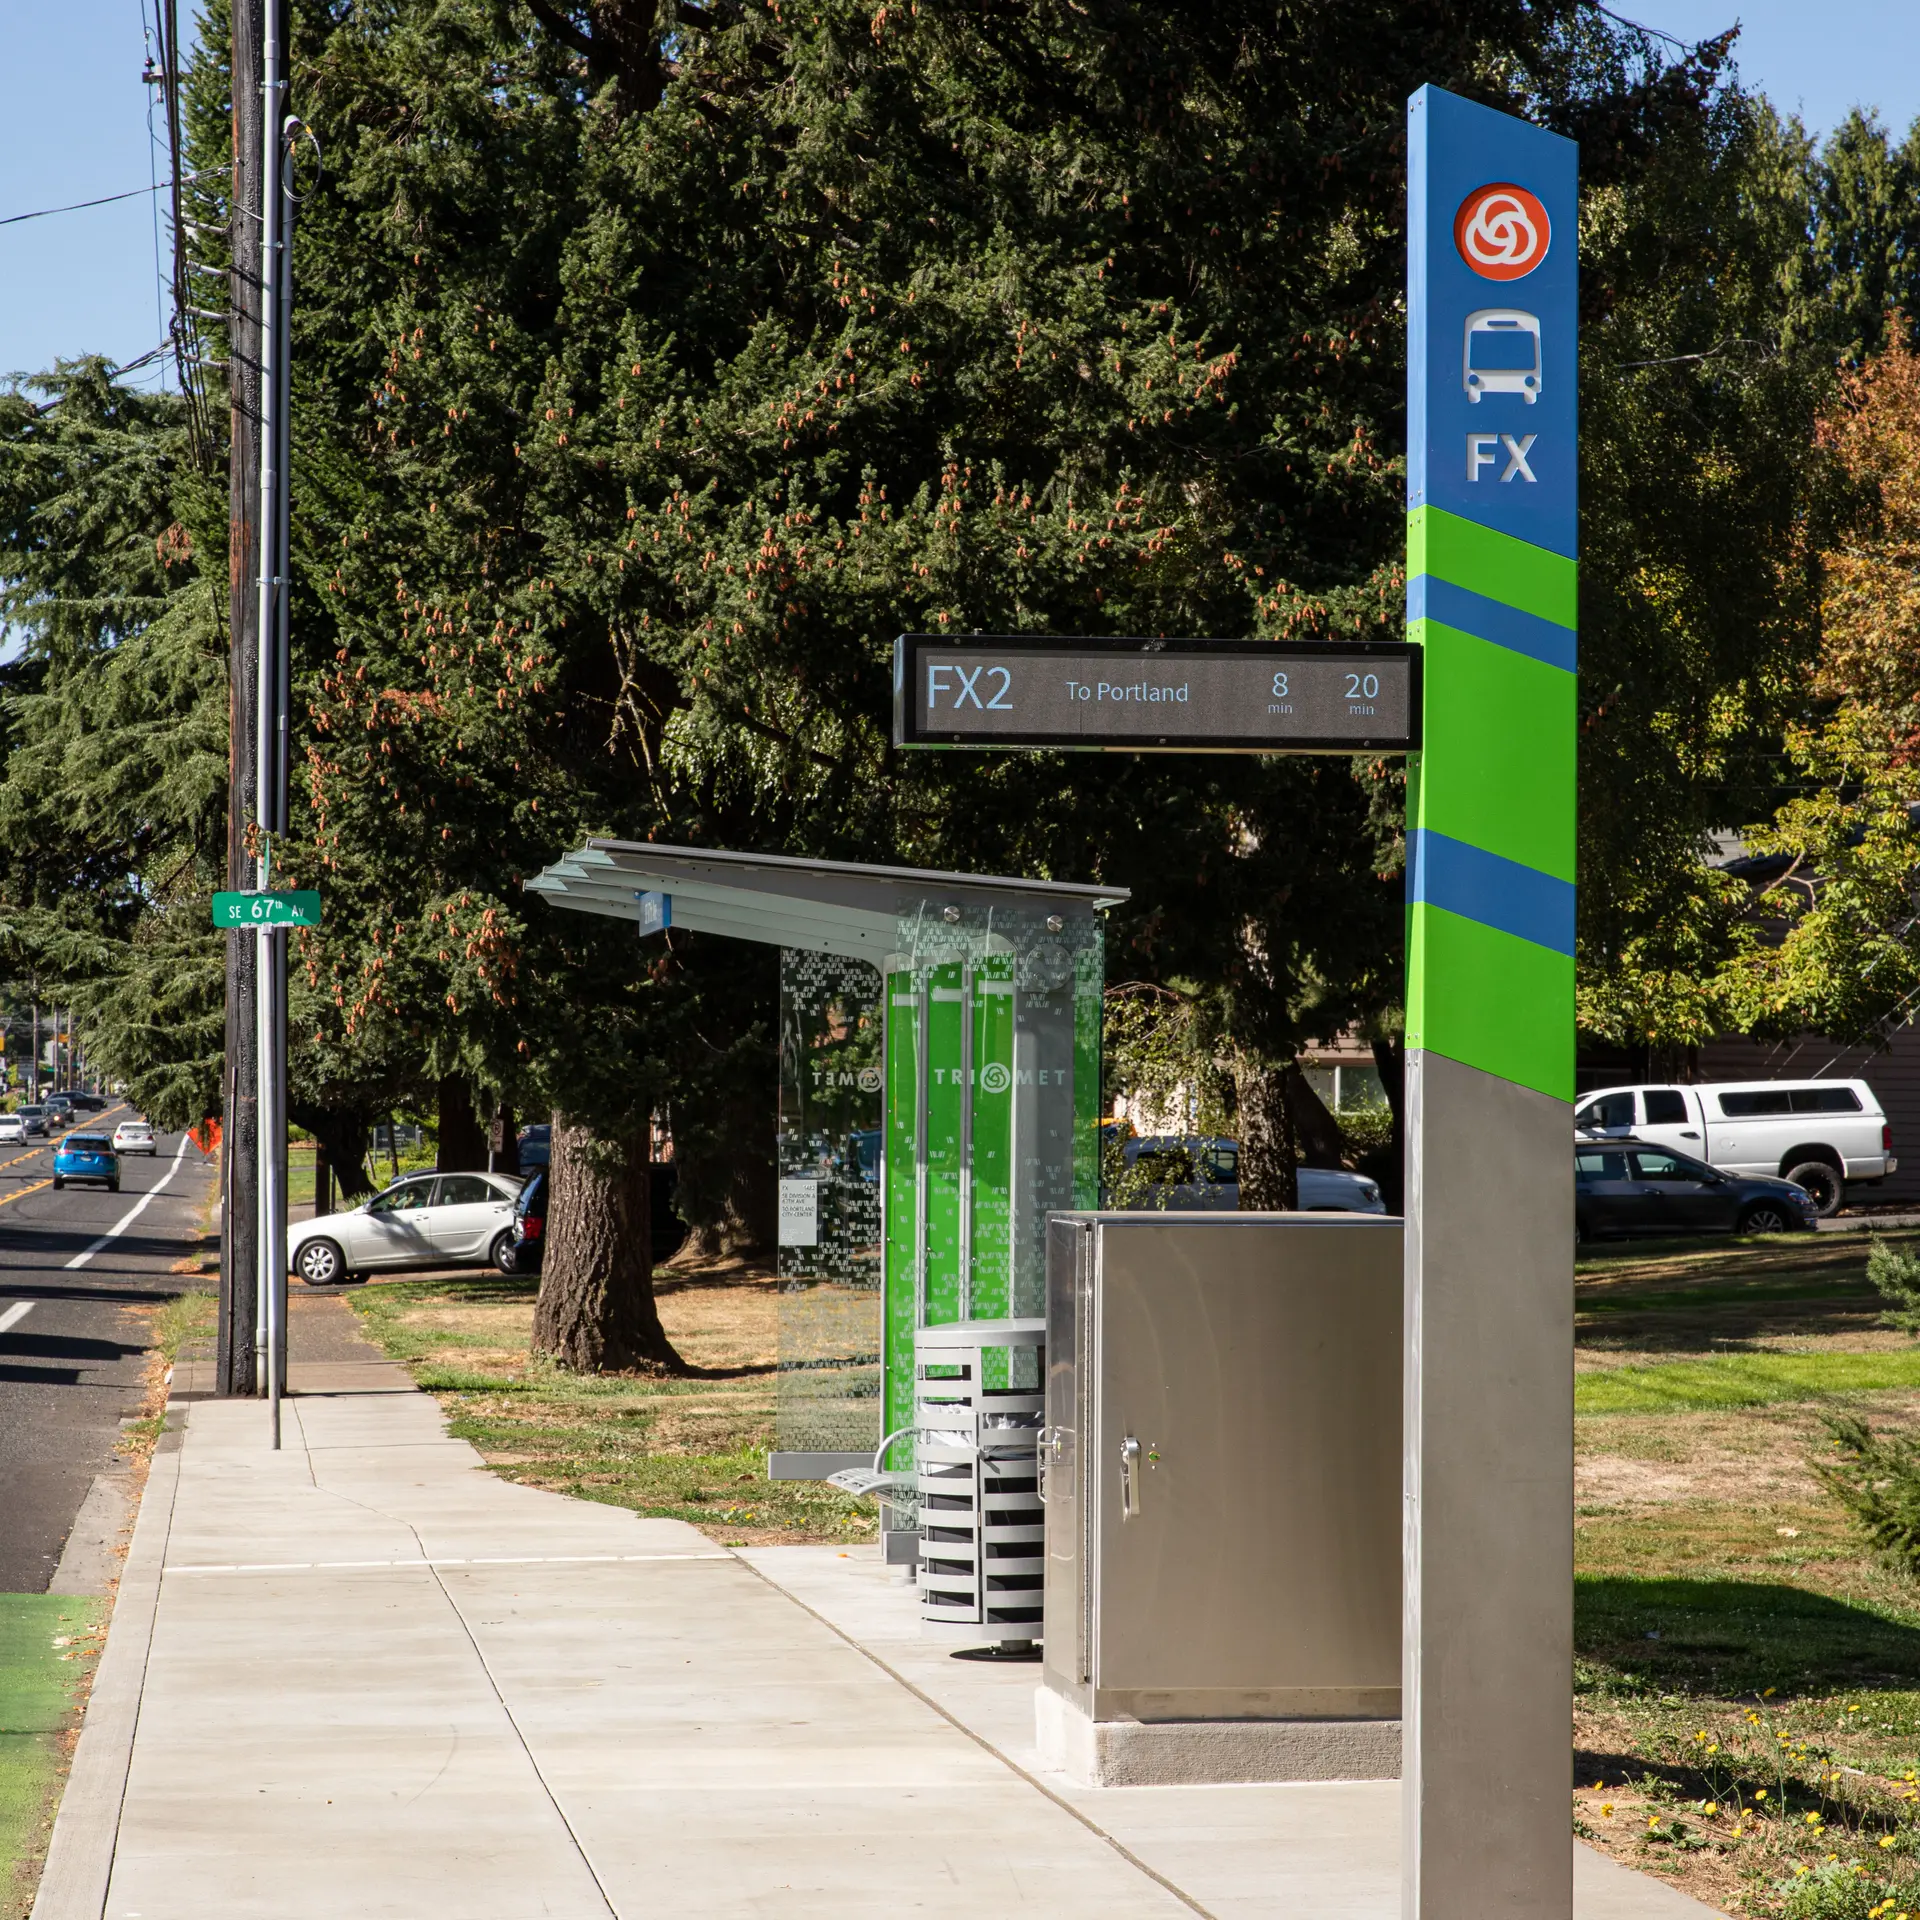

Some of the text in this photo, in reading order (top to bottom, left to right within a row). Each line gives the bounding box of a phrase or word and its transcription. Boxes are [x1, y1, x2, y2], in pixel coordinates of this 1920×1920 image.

[1465, 433, 1538, 482] FX
[926, 665, 1190, 711] FX2 To Portland
[1271, 672, 1289, 699] 8
[1344, 673, 1380, 699] 20
[1267, 702, 1294, 715] min
[1348, 702, 1376, 716] min
[228, 899, 304, 919] SE 67th Av
[934, 1068, 1066, 1086] TRI MET
